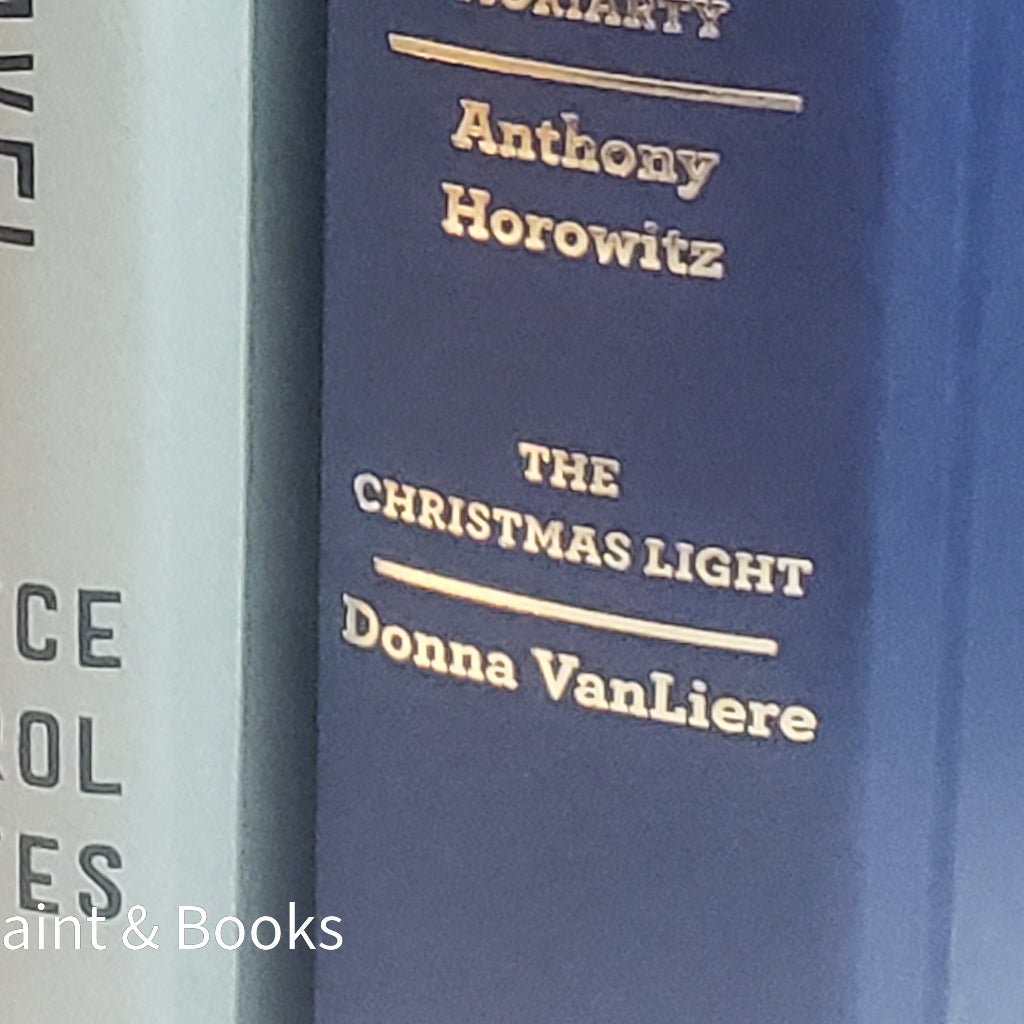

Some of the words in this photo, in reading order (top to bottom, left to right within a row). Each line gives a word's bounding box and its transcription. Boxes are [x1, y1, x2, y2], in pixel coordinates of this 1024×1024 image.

[450, 98, 721, 202] Anthony
[441, 182, 725, 280] Horowitz
[518, 441, 621, 499] THE
[353, 472, 632, 571] CHRISTMAS
[643, 538, 814, 598] LIGHT
[342, 593, 519, 691] Donna
[530, 647, 819, 743] VanLiere
